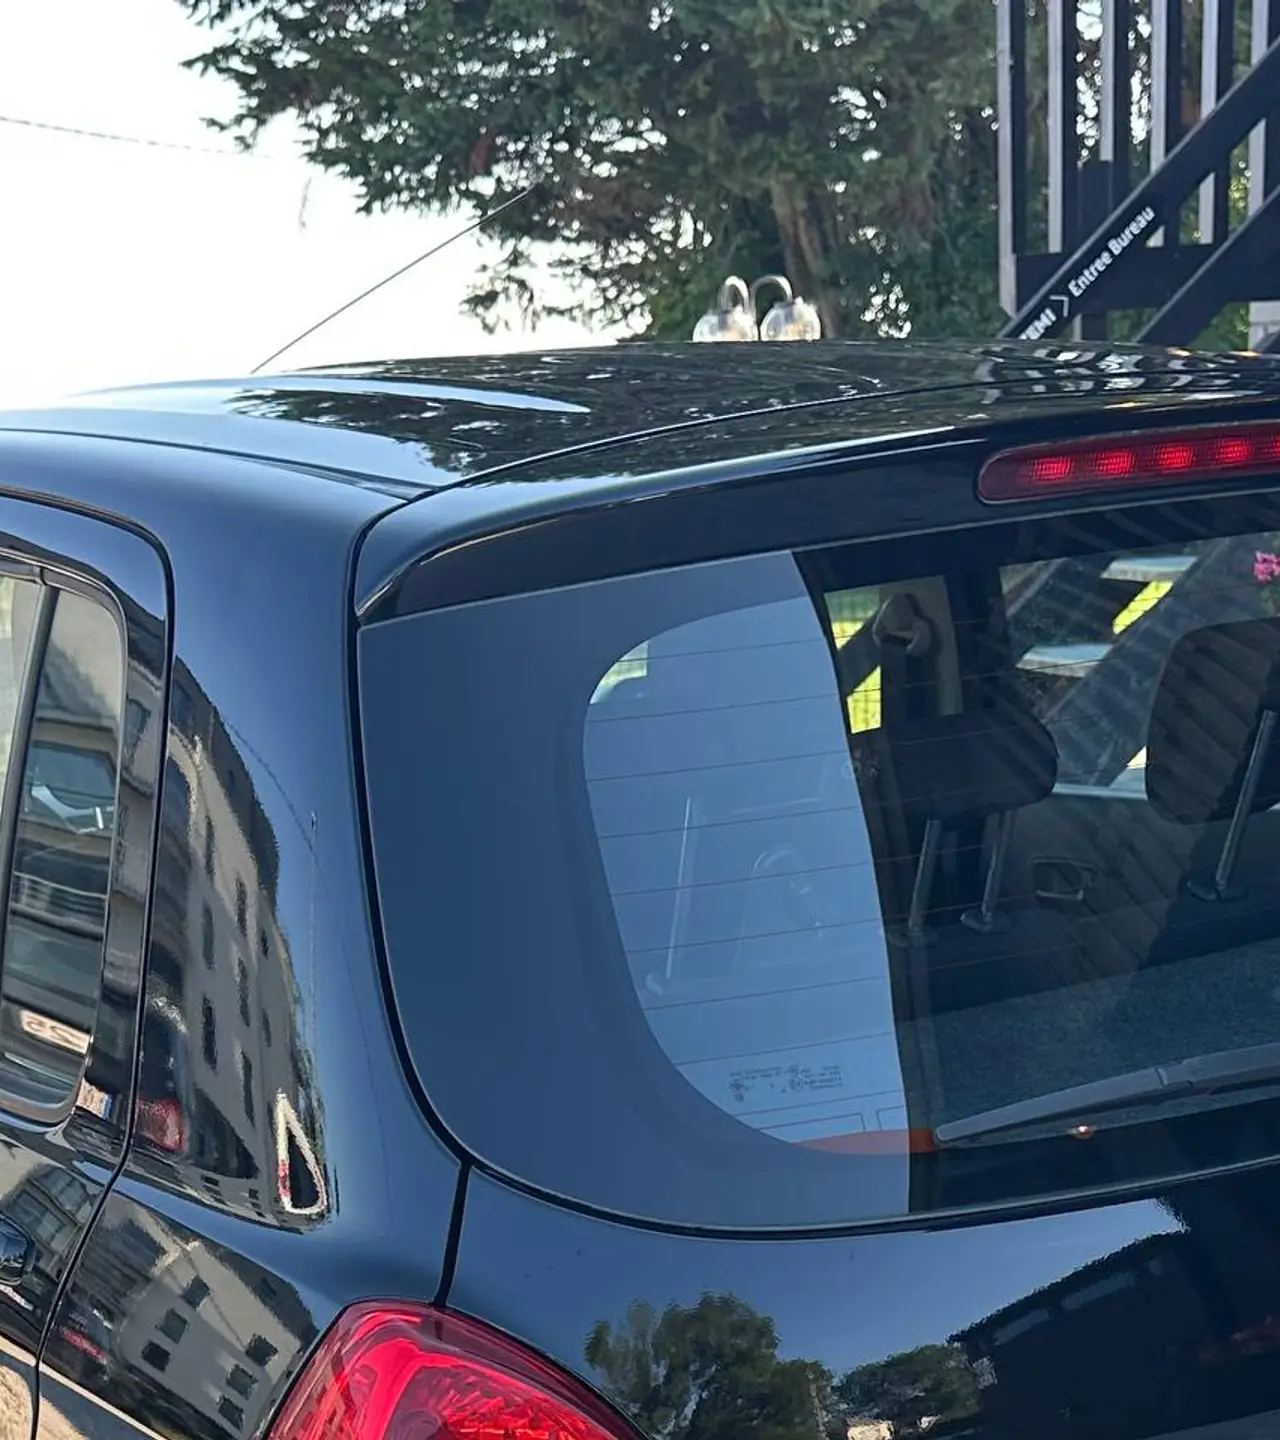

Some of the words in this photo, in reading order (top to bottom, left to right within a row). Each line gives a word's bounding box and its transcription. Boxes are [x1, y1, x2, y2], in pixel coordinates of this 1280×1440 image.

[1018, 307, 1057, 340] EMI
[1068, 250, 1113, 298] Entree
[1107, 206, 1156, 256] Bureau
